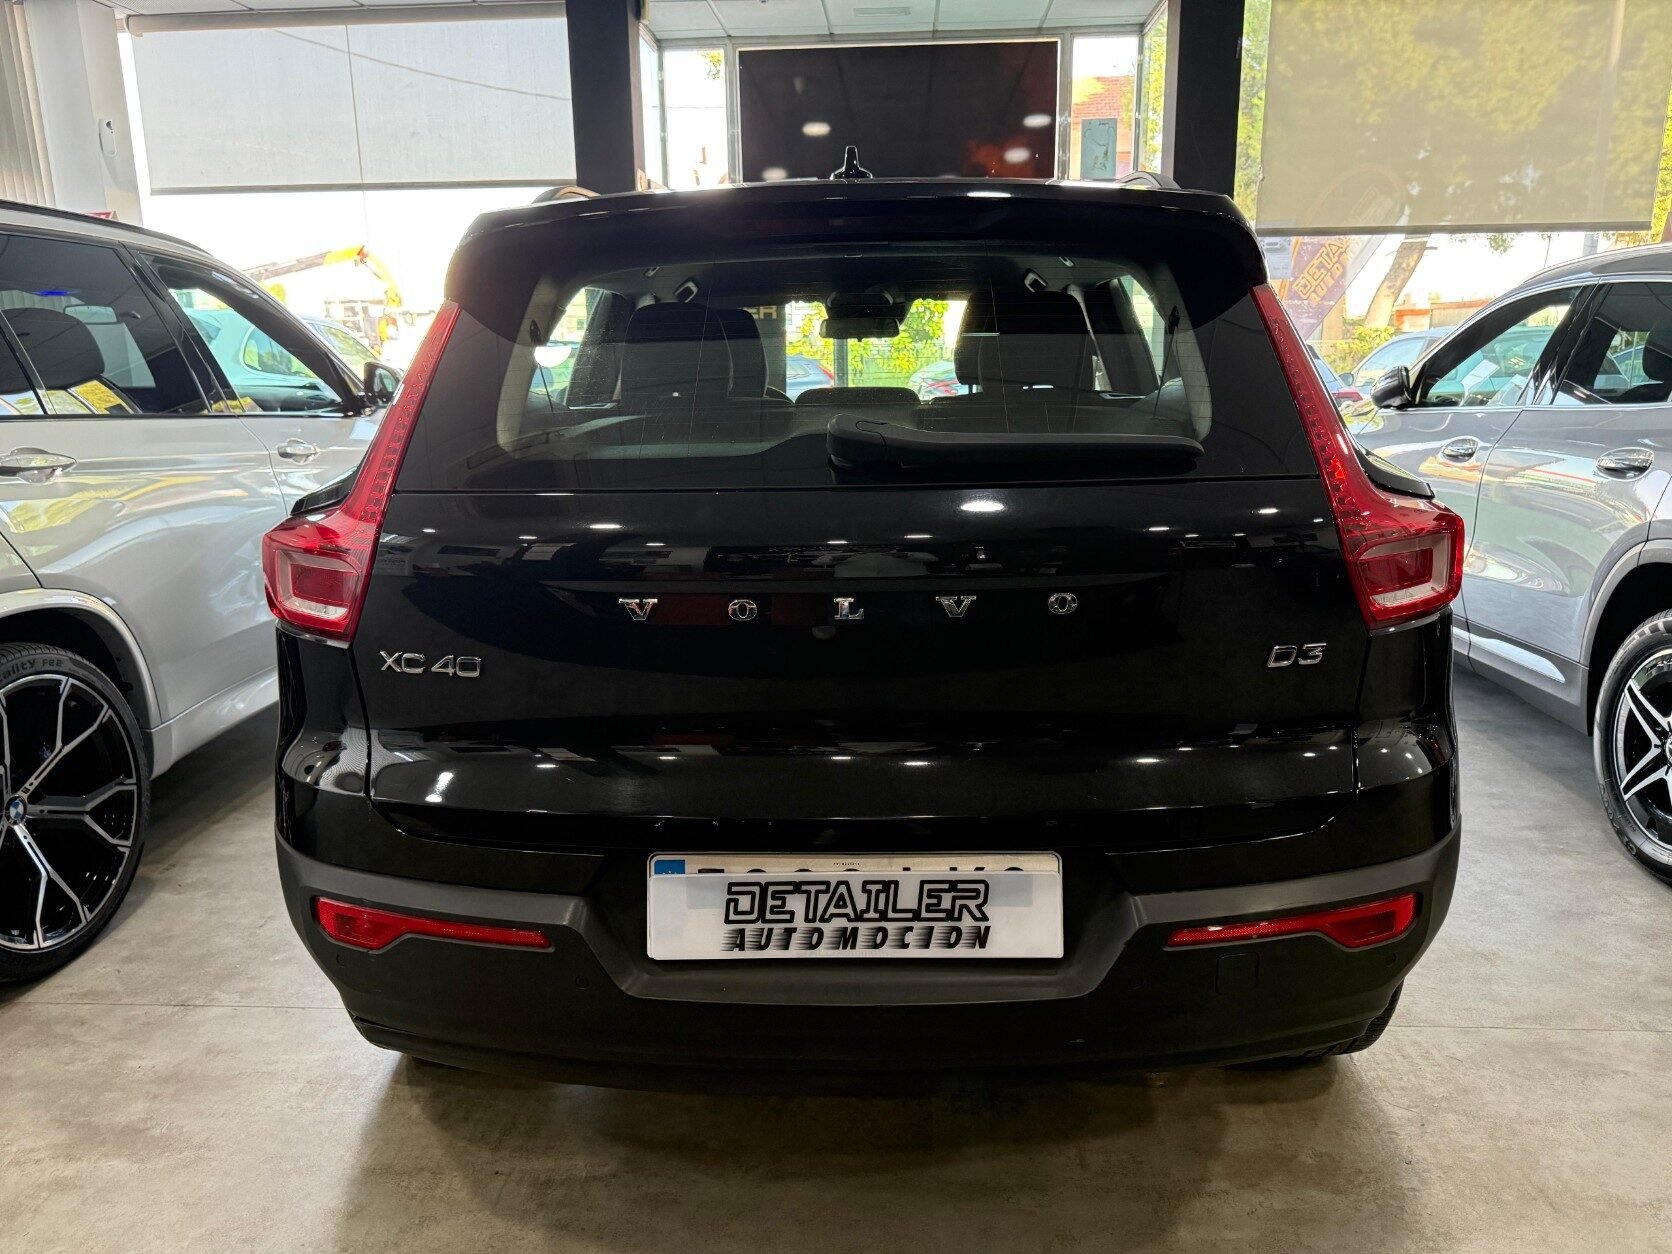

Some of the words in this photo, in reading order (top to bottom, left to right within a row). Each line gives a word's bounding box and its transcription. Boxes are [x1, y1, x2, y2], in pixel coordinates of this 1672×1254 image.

[618, 593, 1079, 621] VOLVO
[1266, 642, 1327, 668] D3
[724, 880, 990, 925] DETAILER
[720, 926, 991, 951] AUTOMOCION
